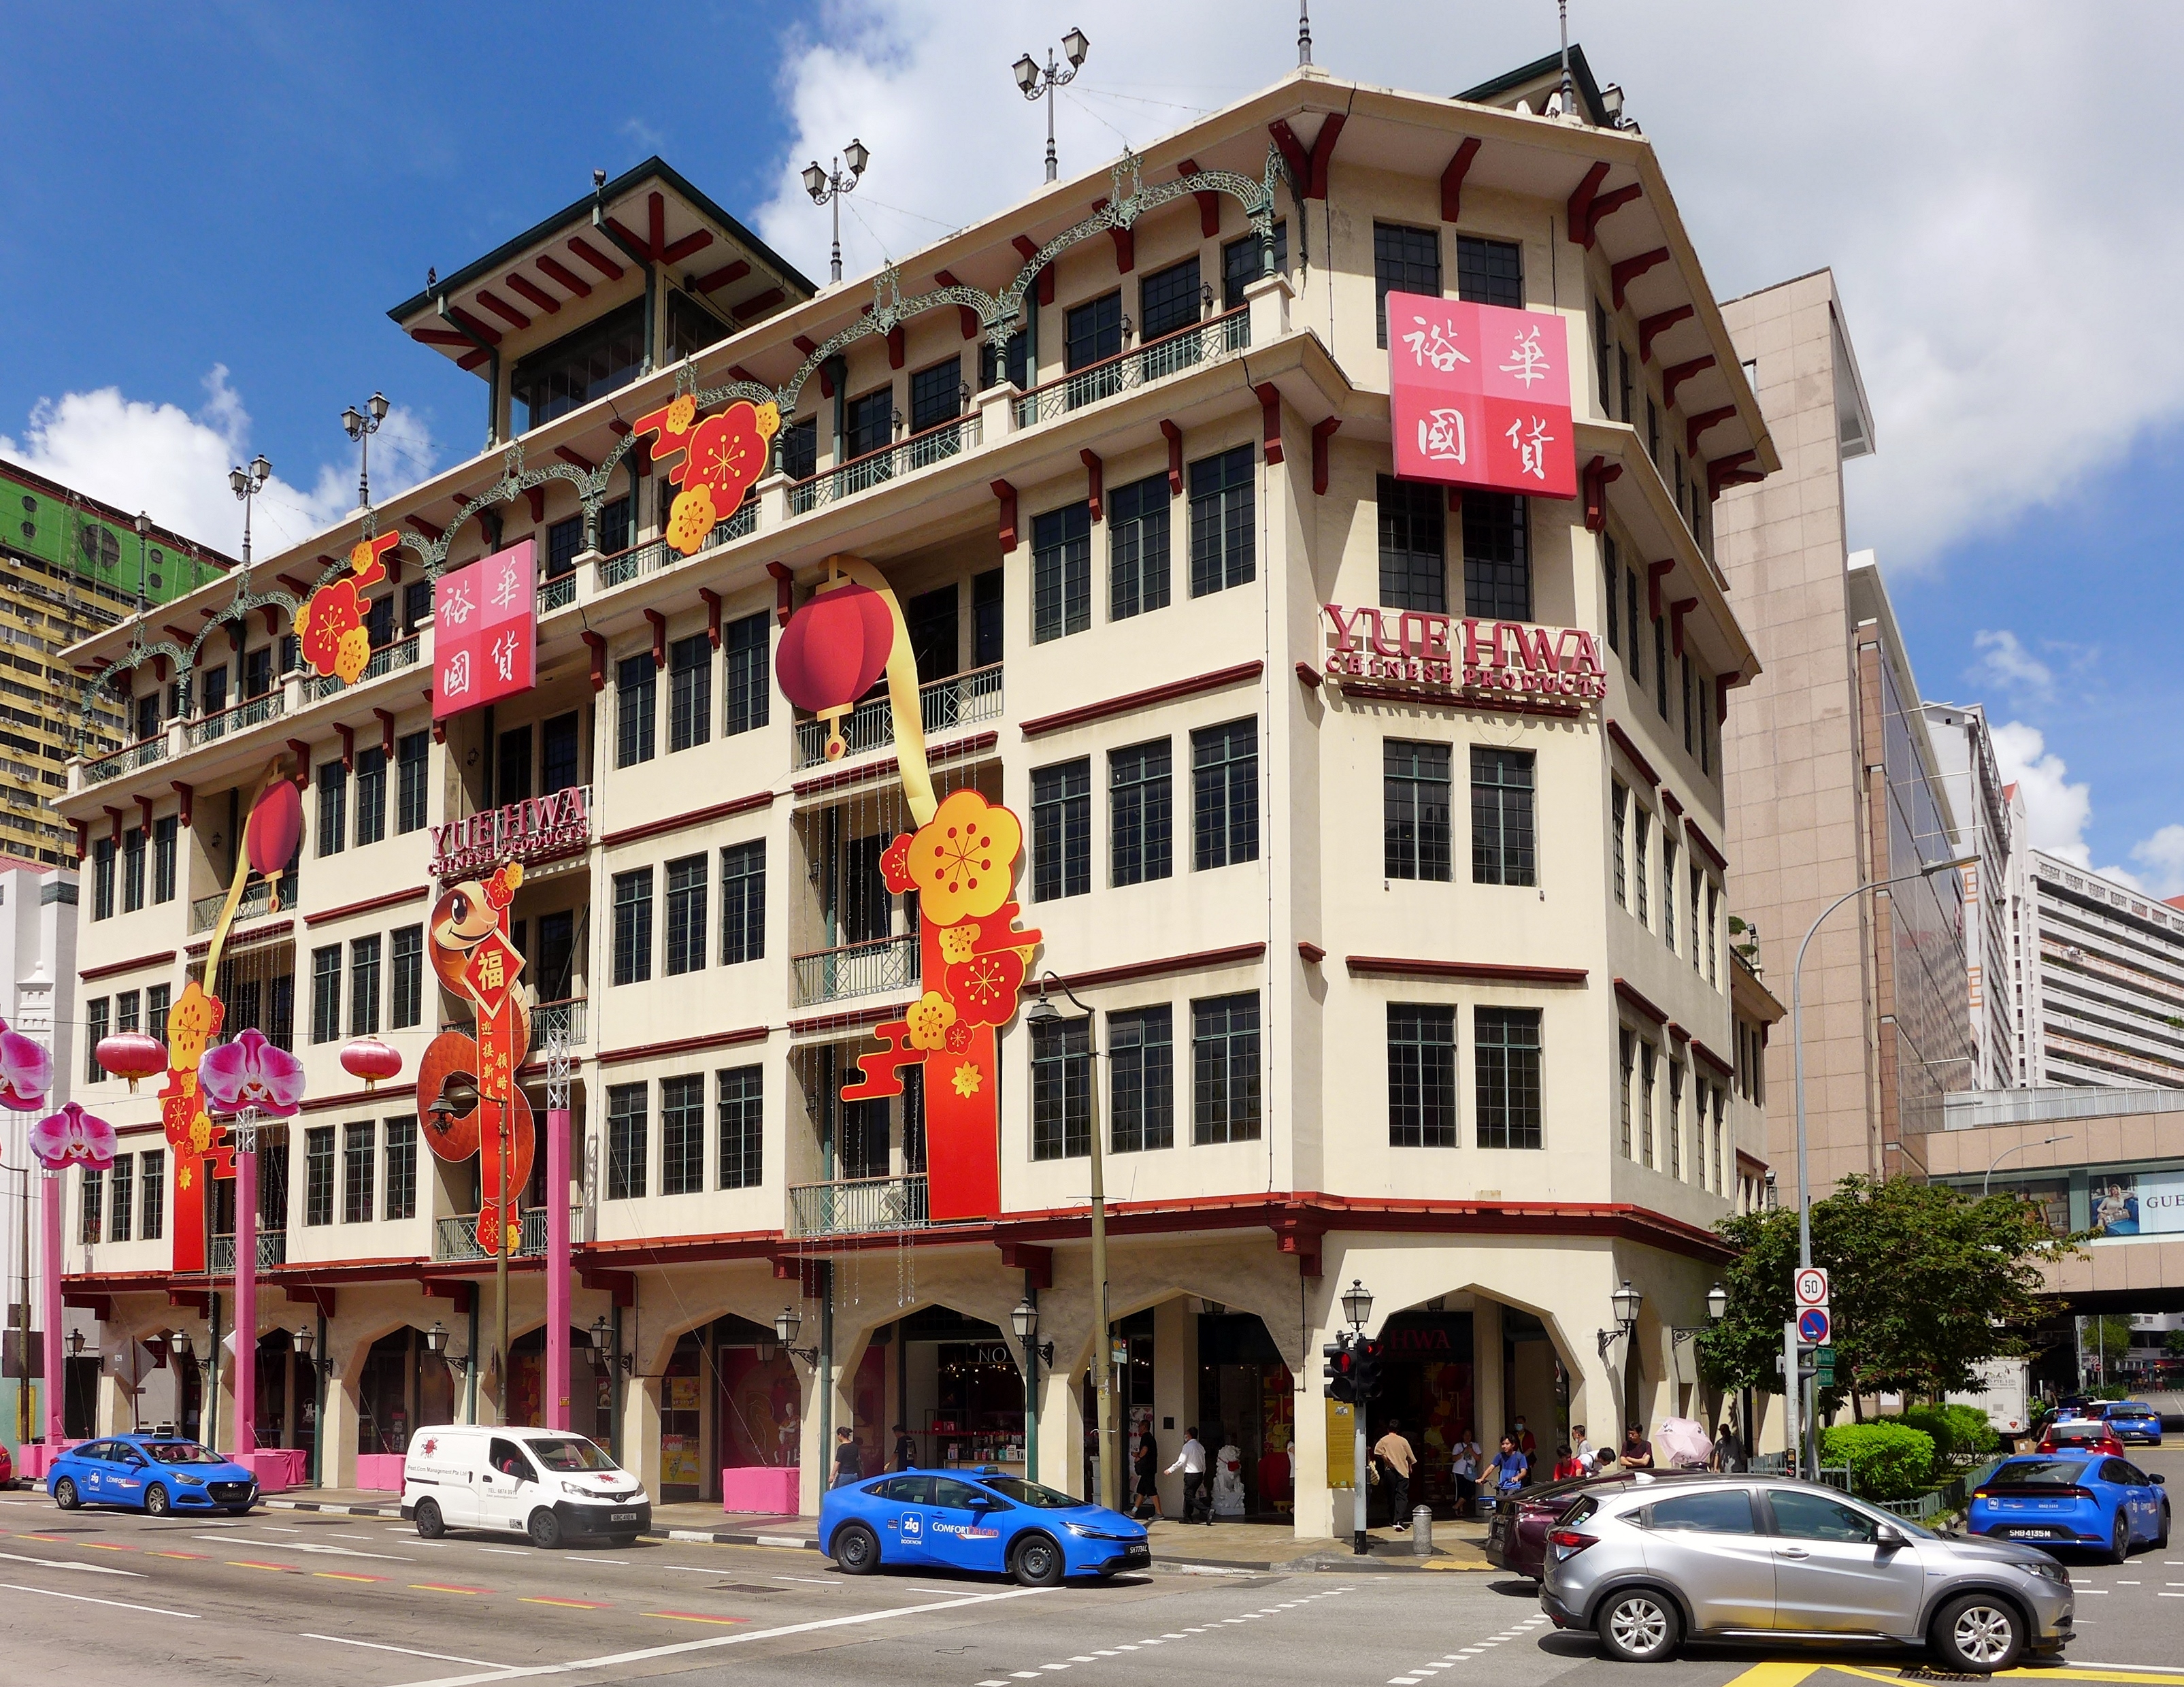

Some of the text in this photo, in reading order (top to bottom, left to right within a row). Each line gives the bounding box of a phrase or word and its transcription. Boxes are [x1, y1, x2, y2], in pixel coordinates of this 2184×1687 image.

[1402, 316, 1551, 389] 裕華
[1418, 408, 1555, 480] 國貨
[440, 555, 520, 627] 裕華
[444, 630, 519, 697] 國貨
[1323, 603, 1607, 678] YUE HWA
[1325, 654, 1608, 699] CHINESE PRODUCTS
[428, 786, 588, 859] YUE HWA
[427, 823, 588, 877] CHINESE PRODUCTS
[477, 948, 504, 992] 福
[1804, 1280, 1818, 1294] 50
[979, 1347, 1006, 1362] NO
[1389, 1329, 1451, 1349] HWA
[427, 1467, 452, 1475] Management
[904, 1517, 919, 1533] zig
